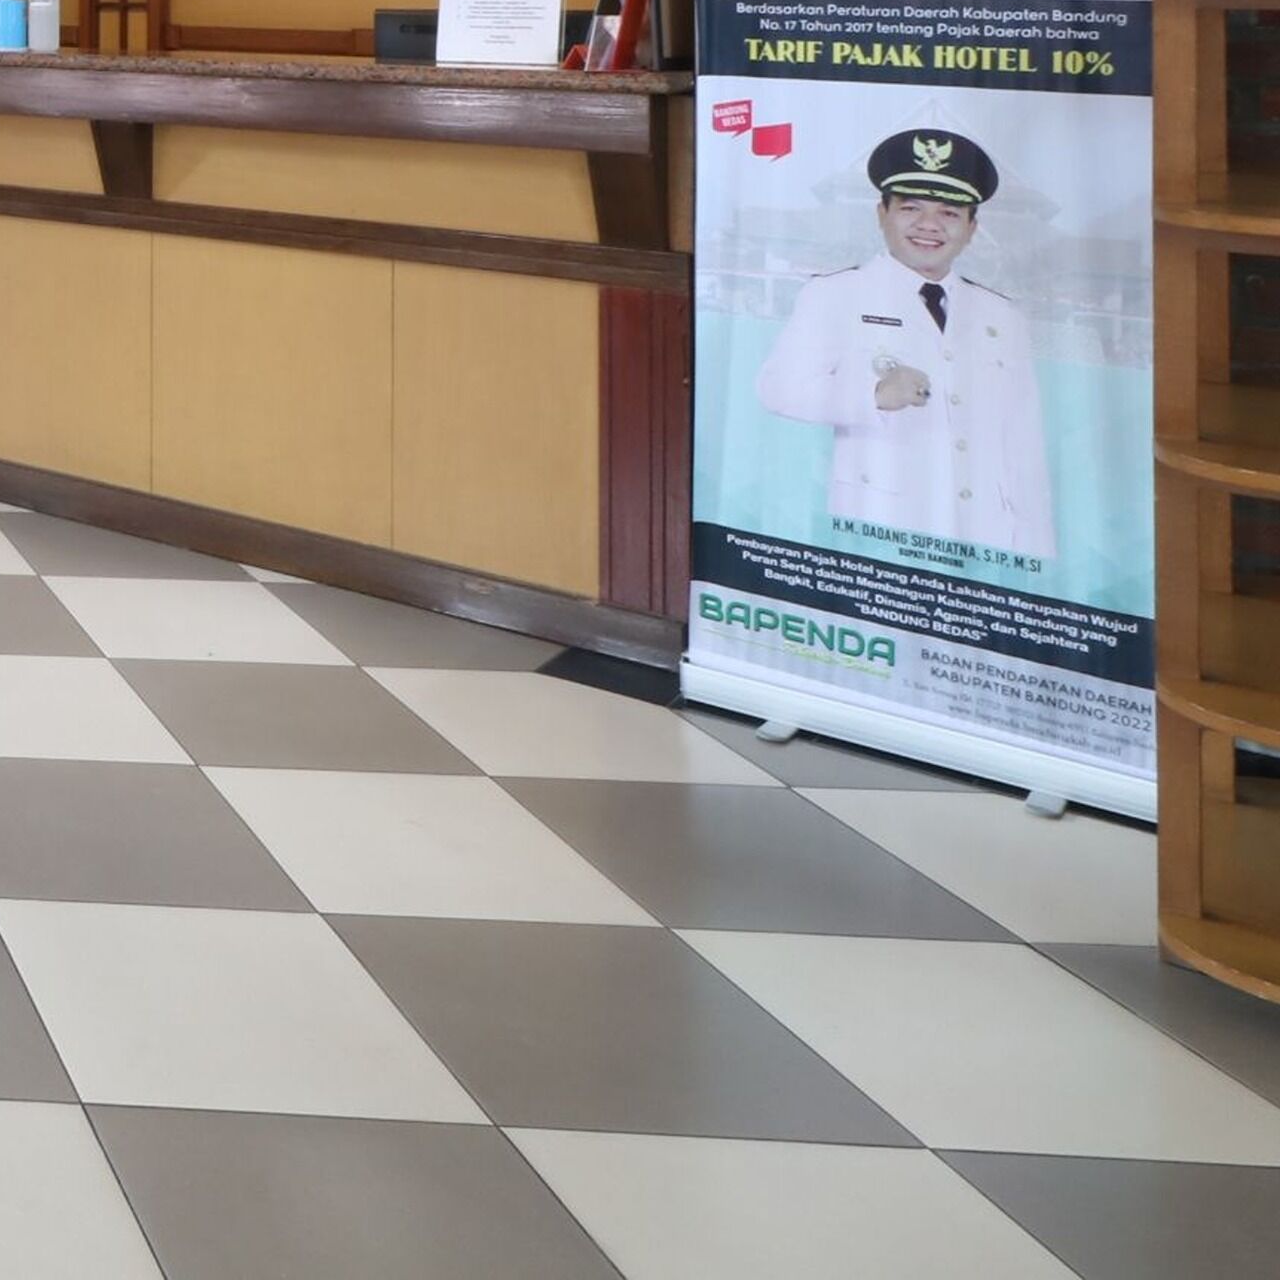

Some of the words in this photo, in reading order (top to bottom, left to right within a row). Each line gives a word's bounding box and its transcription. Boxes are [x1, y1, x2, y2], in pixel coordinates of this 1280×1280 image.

[736, 2, 824, 16] Berdasarkan
[827, 4, 900, 17] Peraturan
[903, 6, 959, 19] Daerah
[962, 7, 1049, 23] Kabupaten
[1052, 9, 1128, 26] Bandung
[759, 19, 781, 31] No.
[784, 20, 797, 31] 17
[800, 20, 842, 33] Tahun
[845, 22, 873, 33] 2017
[876, 22, 934, 38] tentang
[936, 23, 981, 39] Pajak
[983, 25, 1042, 39] Daerah
[1045, 27, 1100, 41] bahwa
[744, 38, 824, 64] TARIF
[832, 41, 924, 68] PAJAK
[933, 45, 1038, 73] HOTEL
[1052, 50, 1115, 76] 10%
[832, 517, 859, 535] H.M.
[862, 523, 909, 545] DADANG
[910, 534, 981, 561] SUPRIATNA,
[726, 533, 801, 559] Pembayaran
[803, 550, 838, 567] Pajak
[840, 558, 874, 575] Hotel
[876, 568, 908, 585] yang
[910, 574, 946, 591] Anda
[948, 582, 1006, 605] Lakukan
[1007, 596, 1089, 623] Merupakan
[1090, 614, 1139, 634] Wujud
[742, 550, 779, 567] Peran
[780, 558, 814, 576] Serta
[815, 568, 854, 584] dalam
[856, 575, 935, 603] Membangun
[937, 593, 1012, 619] Kabupaten
[1014, 611, 1079, 638] Bandung
[1080, 628, 1119, 648] yang
[763, 568, 815, 590] Bangkit,
[816, 580, 873, 604] Edukatif,
[874, 594, 932, 618] Dinamis,
[934, 607, 989, 630] Agamis,
[990, 621, 1017, 637] dan
[1019, 627, 1090, 654] Sejahtera
[698, 592, 896, 668] BAPENDA
[921, 648, 973, 670] BADAN
[975, 661, 1082, 698] PENDAPATAN
[1084, 689, 1152, 716] DAERAH
[930, 666, 1022, 699] KABUPATEN
[1024, 690, 1107, 722] BANDUNG
[1110, 712, 1152, 733] 2022
